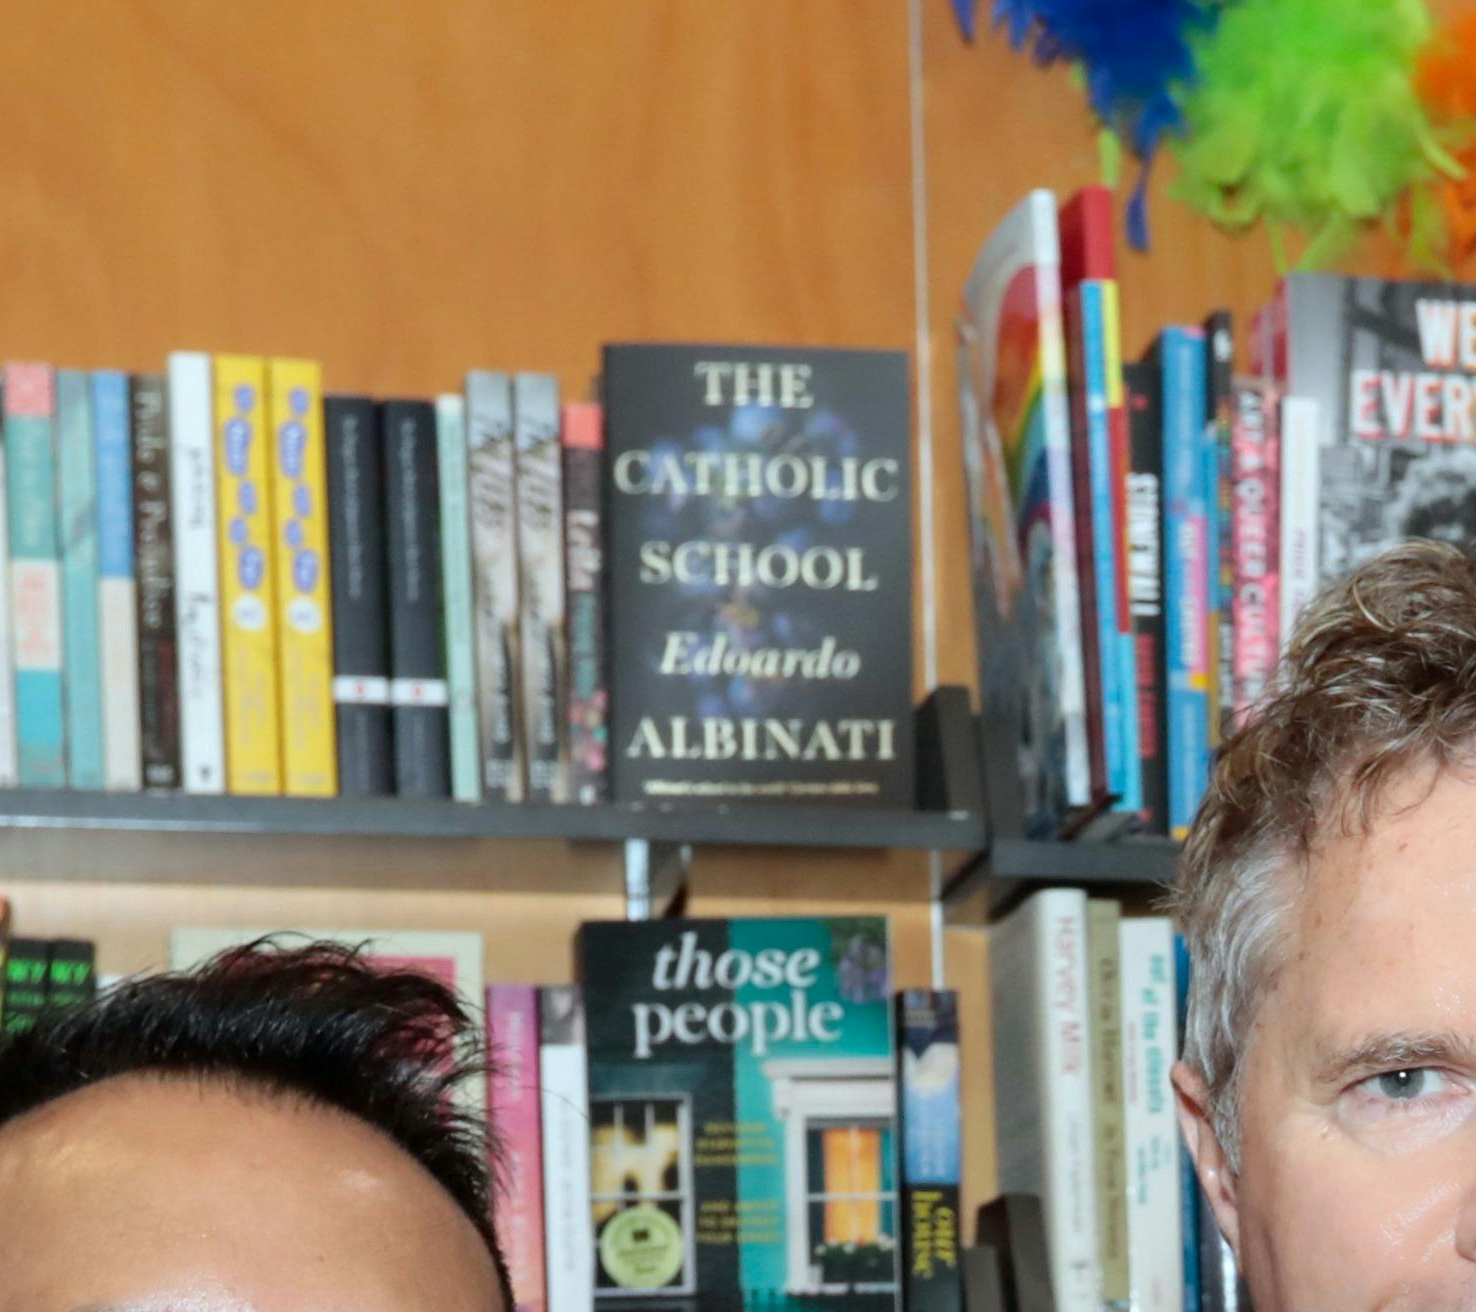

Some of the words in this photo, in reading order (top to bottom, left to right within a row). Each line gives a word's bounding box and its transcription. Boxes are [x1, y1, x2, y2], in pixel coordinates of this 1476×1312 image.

[695, 360, 814, 409] THE
[613, 450, 900, 502] CATHOLIC
[1235, 476, 1266, 577] QUEER
[638, 541, 878, 591] SCHOOL
[659, 631, 861, 681] Edoardo
[626, 717, 896, 761] ALBINATI
[653, 931, 821, 992] those
[632, 991, 844, 1059] people
